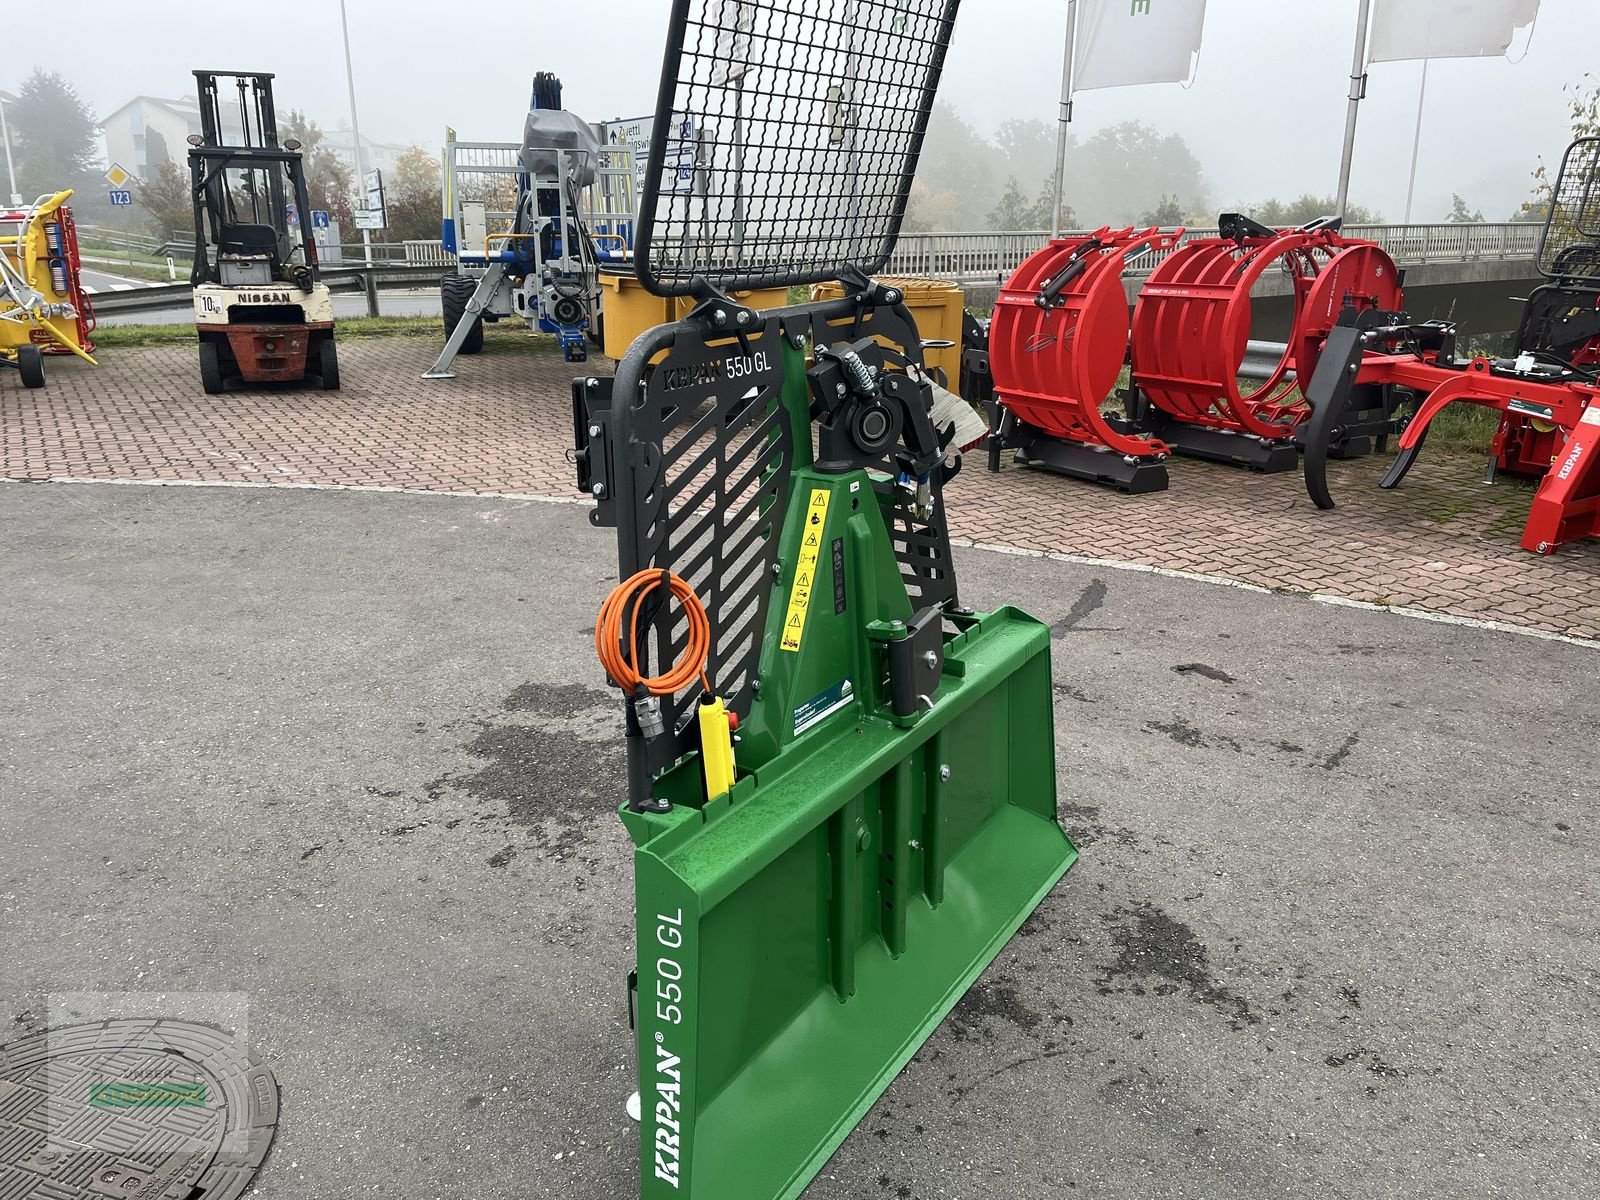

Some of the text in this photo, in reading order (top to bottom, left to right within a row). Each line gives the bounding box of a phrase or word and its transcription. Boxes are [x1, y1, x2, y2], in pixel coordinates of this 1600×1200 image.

[111, 191, 131, 204] 123
[201, 296, 213, 311] 10
[238, 293, 291, 303] NISSAN
[726, 356, 752, 379] 550
[754, 351, 771, 372] GL
[1557, 442, 1583, 480] KRPAN
[656, 908, 682, 948] GL
[656, 957, 682, 1025] 550
